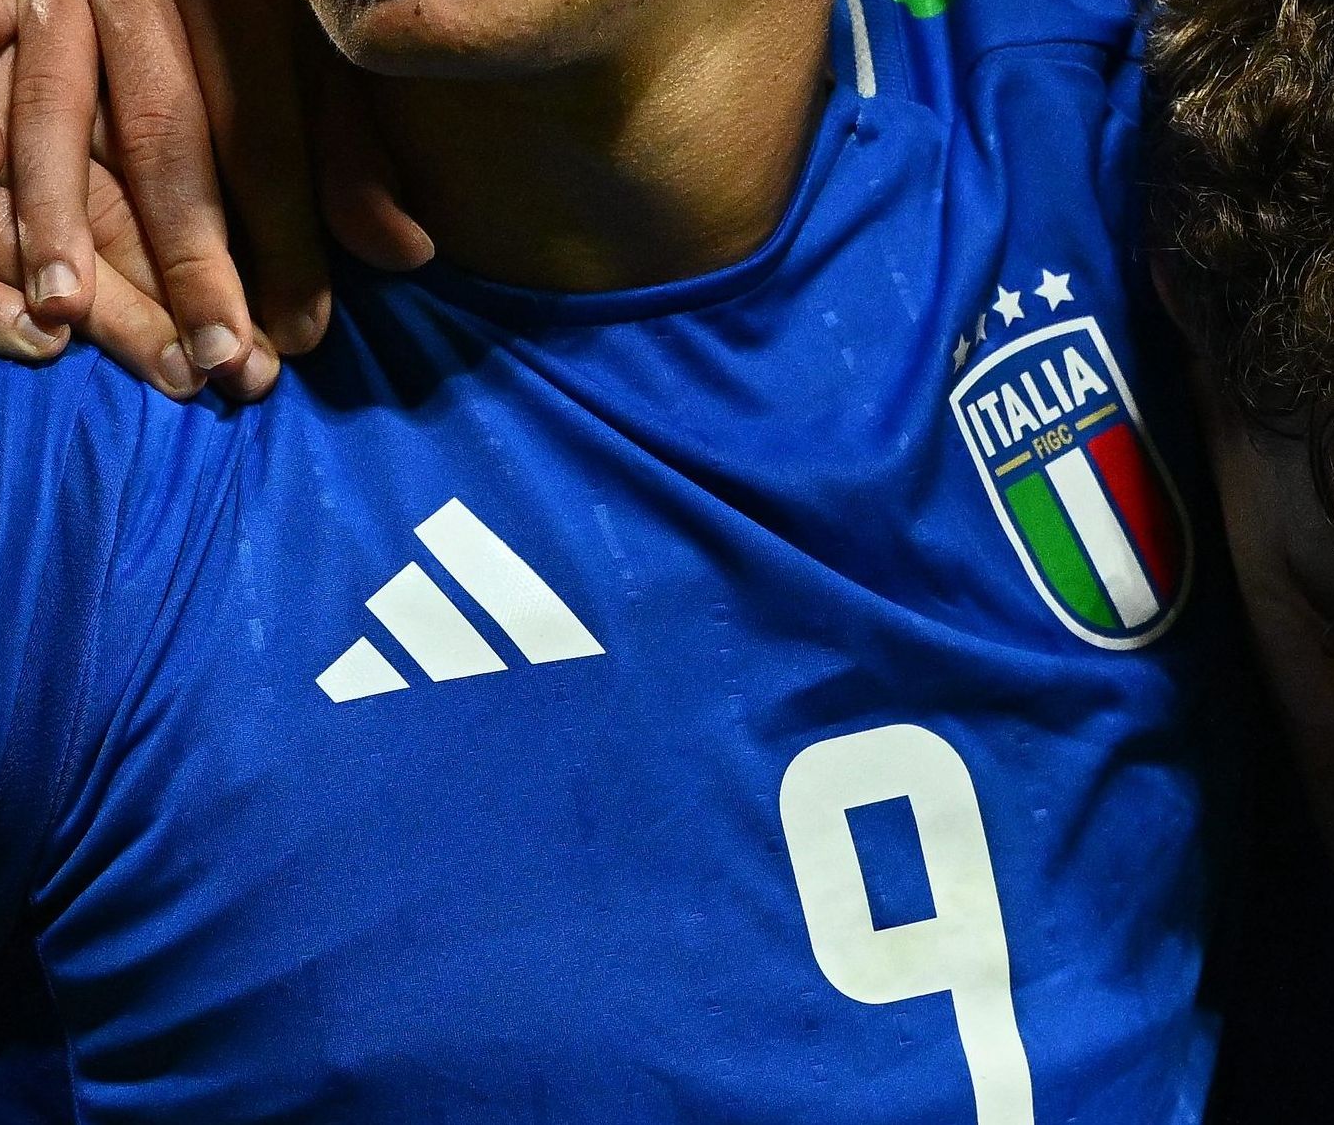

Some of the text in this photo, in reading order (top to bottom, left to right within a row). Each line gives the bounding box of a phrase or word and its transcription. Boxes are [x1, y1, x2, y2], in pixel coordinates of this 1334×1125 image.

[967, 346, 1108, 458] ITALIA
[1031, 423, 1074, 460] FIGC
[779, 724, 1035, 1125] 9
